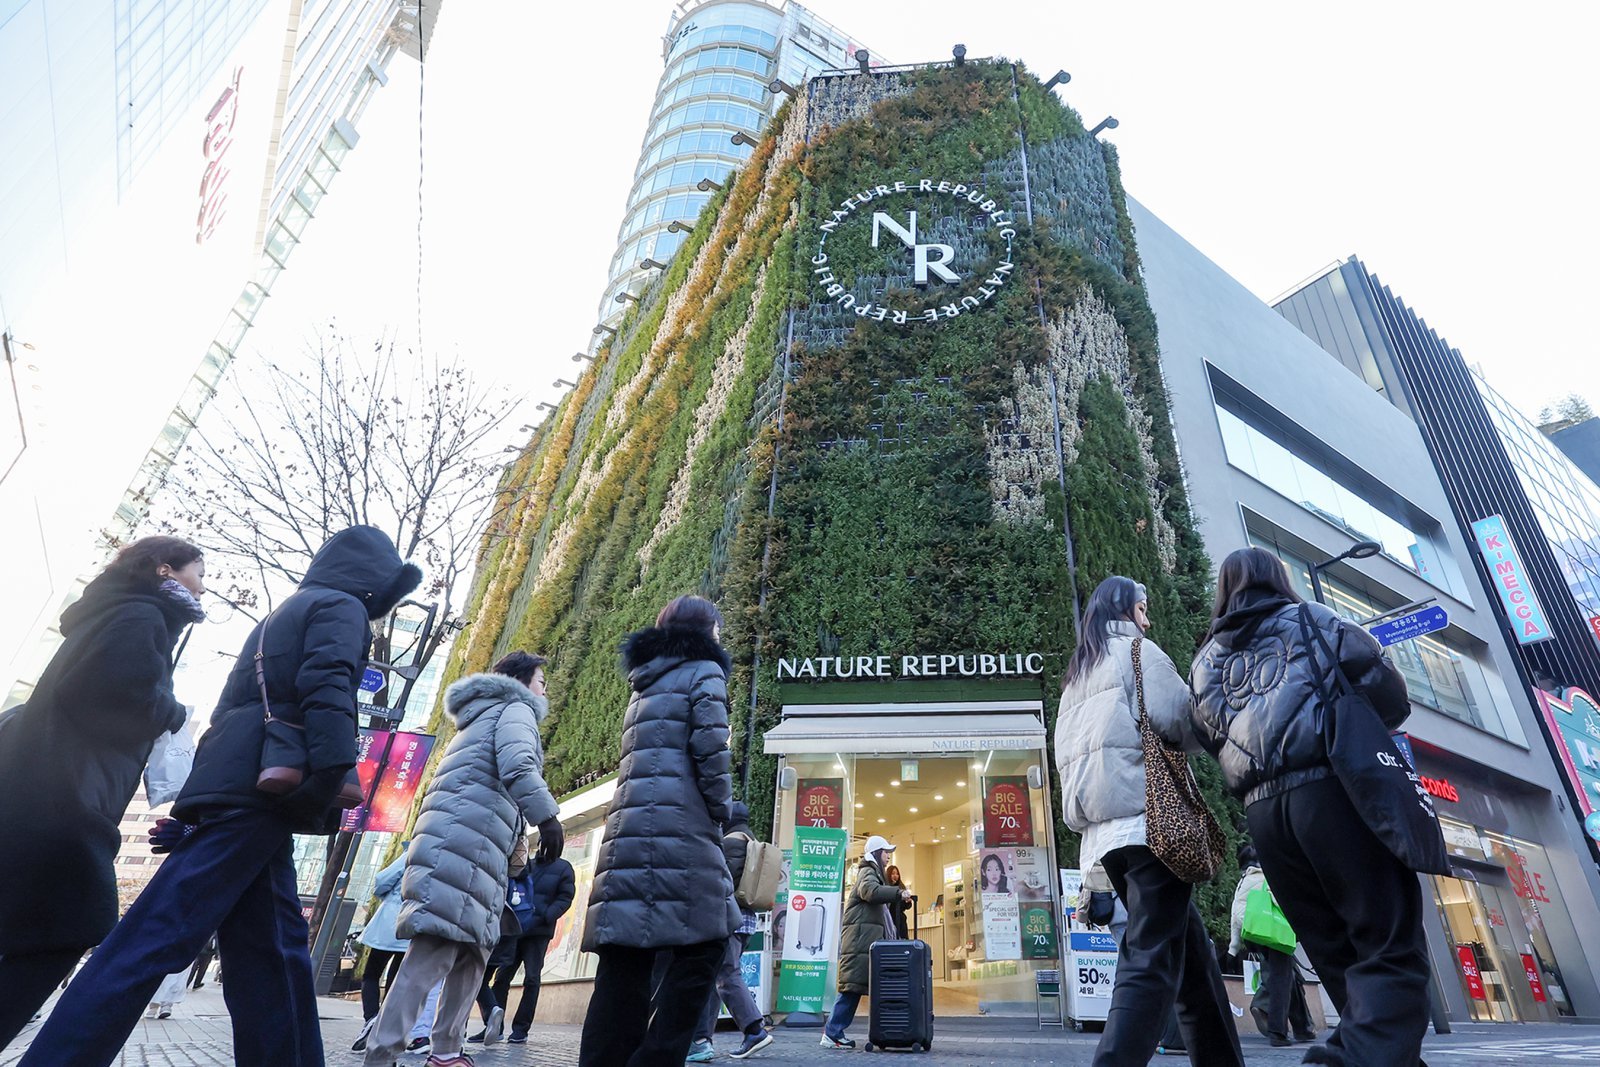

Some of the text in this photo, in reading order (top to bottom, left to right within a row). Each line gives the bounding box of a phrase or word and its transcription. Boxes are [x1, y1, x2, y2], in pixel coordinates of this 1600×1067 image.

[819, 178, 1017, 240] NATURE REPUBLIC
[812, 253, 1014, 324] NATURE REPUBLIC
[1384, 624, 1419, 639] Myeongdong
[778, 653, 1045, 679] NATURE REPUBLIC
[932, 738, 1033, 750] NATURE REPUBLIC
[1420, 775, 1459, 803] conds
[809, 794, 829, 805] BIG
[995, 792, 1016, 803] BIG
[803, 805, 835, 817] SALE
[990, 803, 1023, 815] SALE
[802, 844, 836, 856] EVENT
[1507, 866, 1550, 903] SALE
[1030, 915, 1046, 924] BIG
[1026, 924, 1051, 934] SALE
[1078, 958, 1094, 966] BUY
[1078, 968, 1110, 984] 50%
[1463, 965, 1478, 977] SALE
[1526, 971, 1539, 983] SALE
[1079, 986, 1095, 995] 세일
